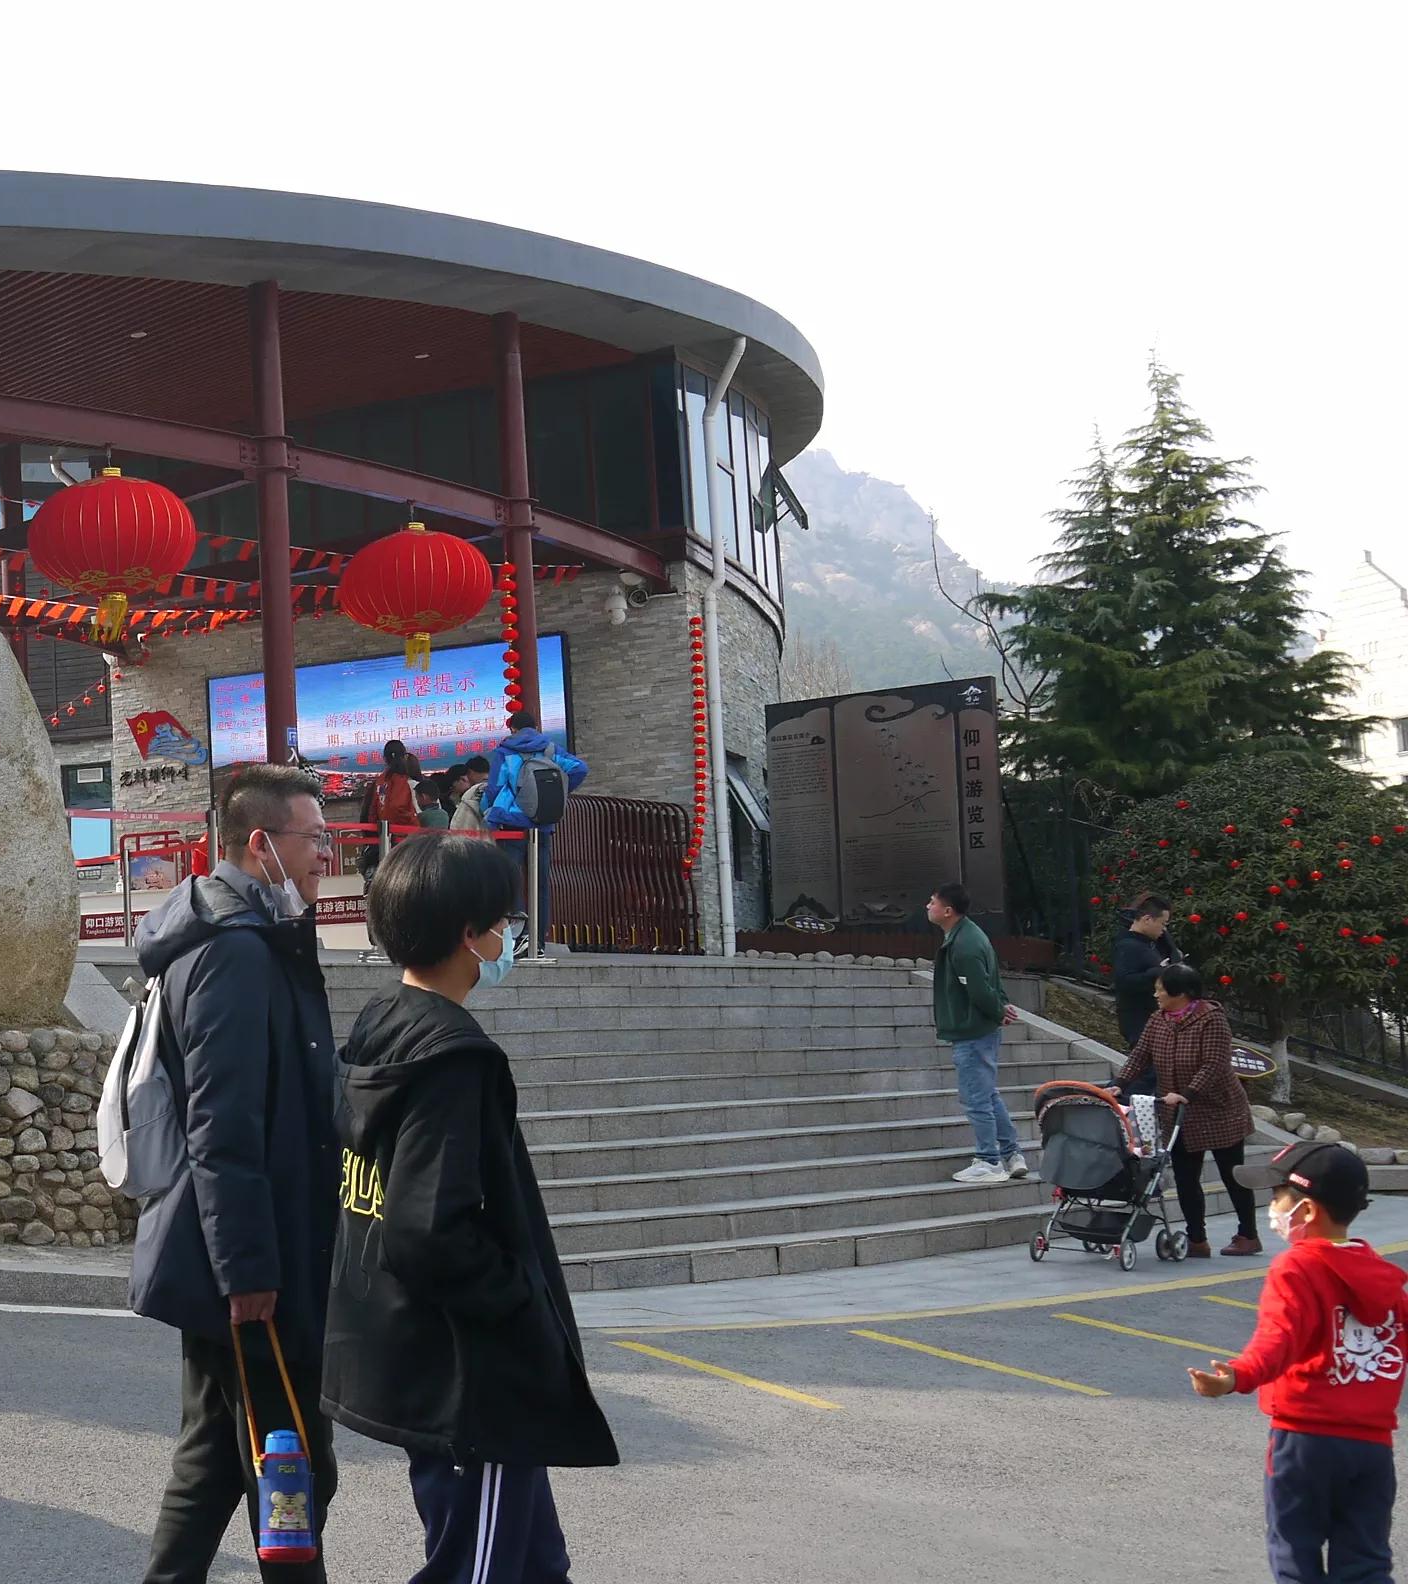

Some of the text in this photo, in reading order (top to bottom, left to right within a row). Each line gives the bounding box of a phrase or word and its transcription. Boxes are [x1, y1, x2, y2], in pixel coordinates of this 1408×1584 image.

[392, 670, 475, 699] 温馨提示
[963, 729, 985, 849] 仰口游览区
